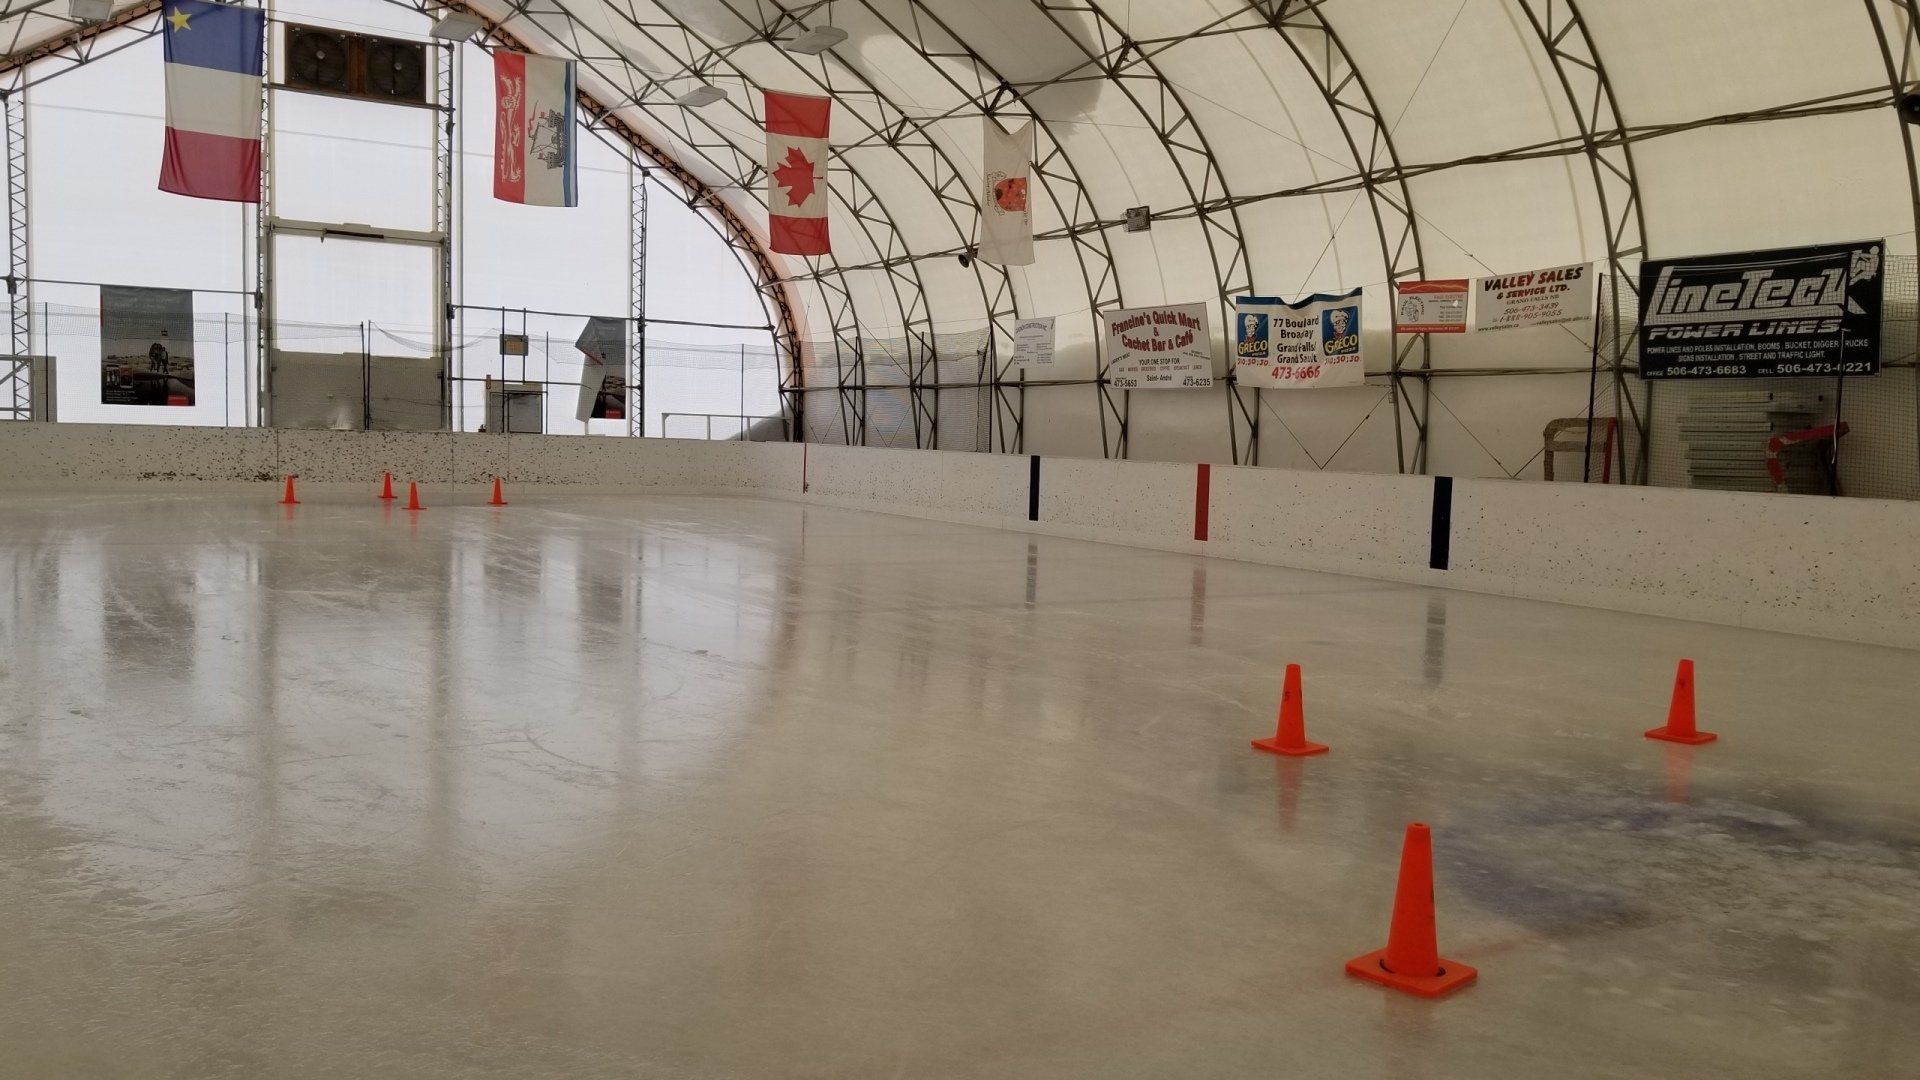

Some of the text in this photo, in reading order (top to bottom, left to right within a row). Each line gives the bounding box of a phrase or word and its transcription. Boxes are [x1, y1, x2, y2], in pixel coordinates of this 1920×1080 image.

[1484, 266, 1584, 291] VALLEY SALES
[1496, 284, 1570, 300] & SERVICE LTD.
[1112, 310, 1202, 337] Francine's Quick Mart
[1273, 318, 1284, 328] 77
[1648, 319, 1843, 341] POWER LINES
[1153, 327, 1160, 337] &
[1121, 329, 1194, 352] Cachet Bar & Café
[1694, 344, 1714, 353] POLES
[1757, 342, 1781, 350] BOOMS
[1813, 340, 1840, 349] DIGGER
[1841, 338, 1869, 348] RUCKS
[1277, 354, 1299, 364] Grand
[1739, 352, 1763, 361] STREET
[1763, 351, 1777, 360] AND
[1778, 350, 1804, 359] TRAFFIC
[1667, 364, 1748, 377] 506-473-6683
[1182, 378, 1211, 387] 473-6235
